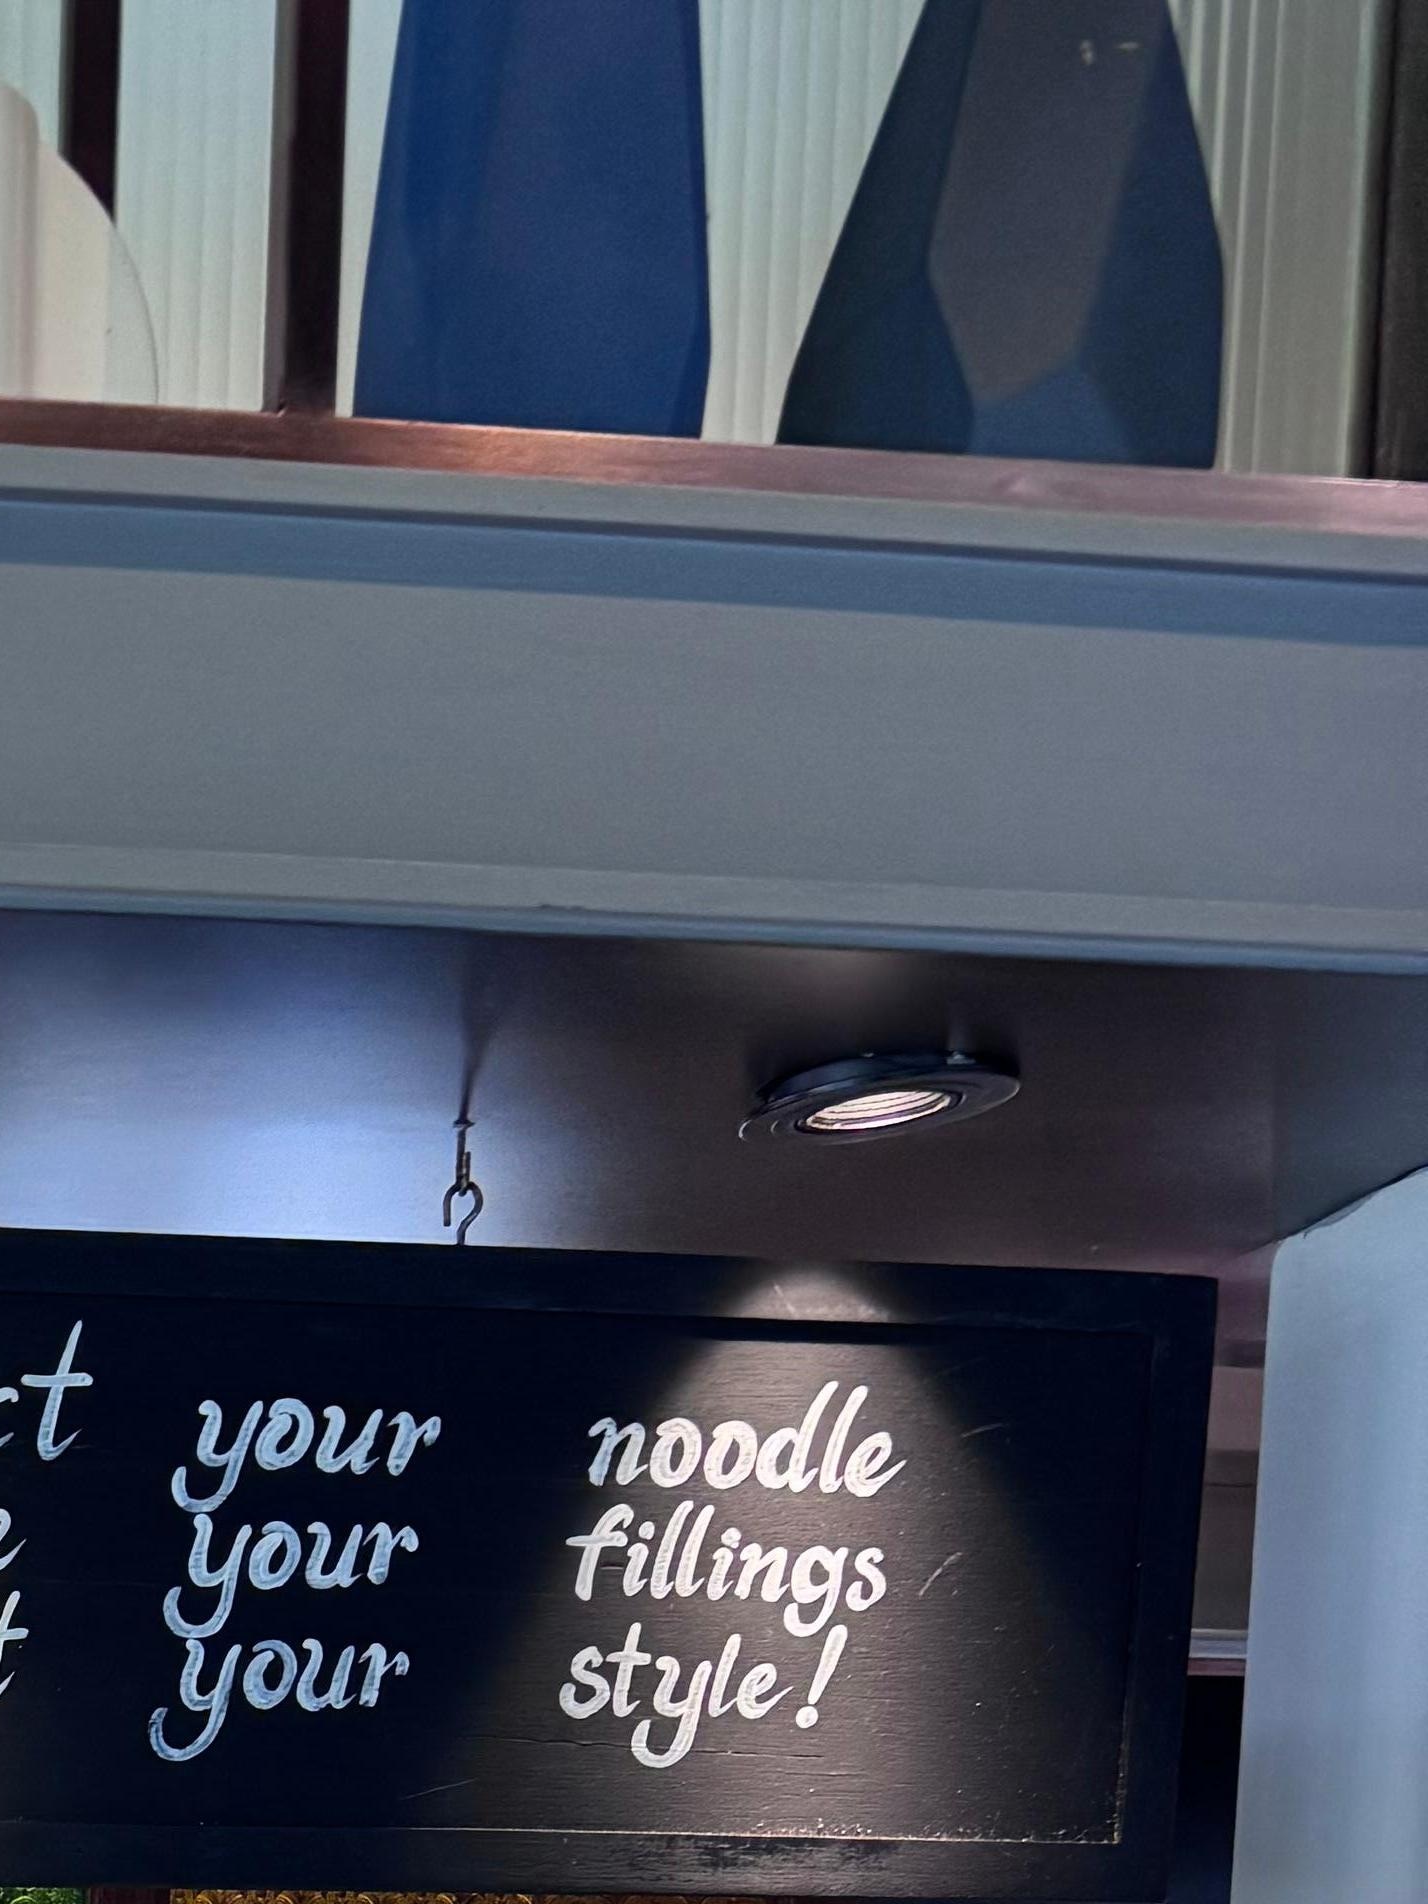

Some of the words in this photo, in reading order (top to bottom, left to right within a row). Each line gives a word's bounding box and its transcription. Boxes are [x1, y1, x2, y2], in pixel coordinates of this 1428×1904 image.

[171, 1397, 442, 1513] your
[586, 1380, 907, 1498] noodle
[162, 1512, 418, 1641] your
[564, 1500, 890, 1641] fillings
[149, 1635, 411, 1761] your
[559, 1622, 848, 1771] style!
